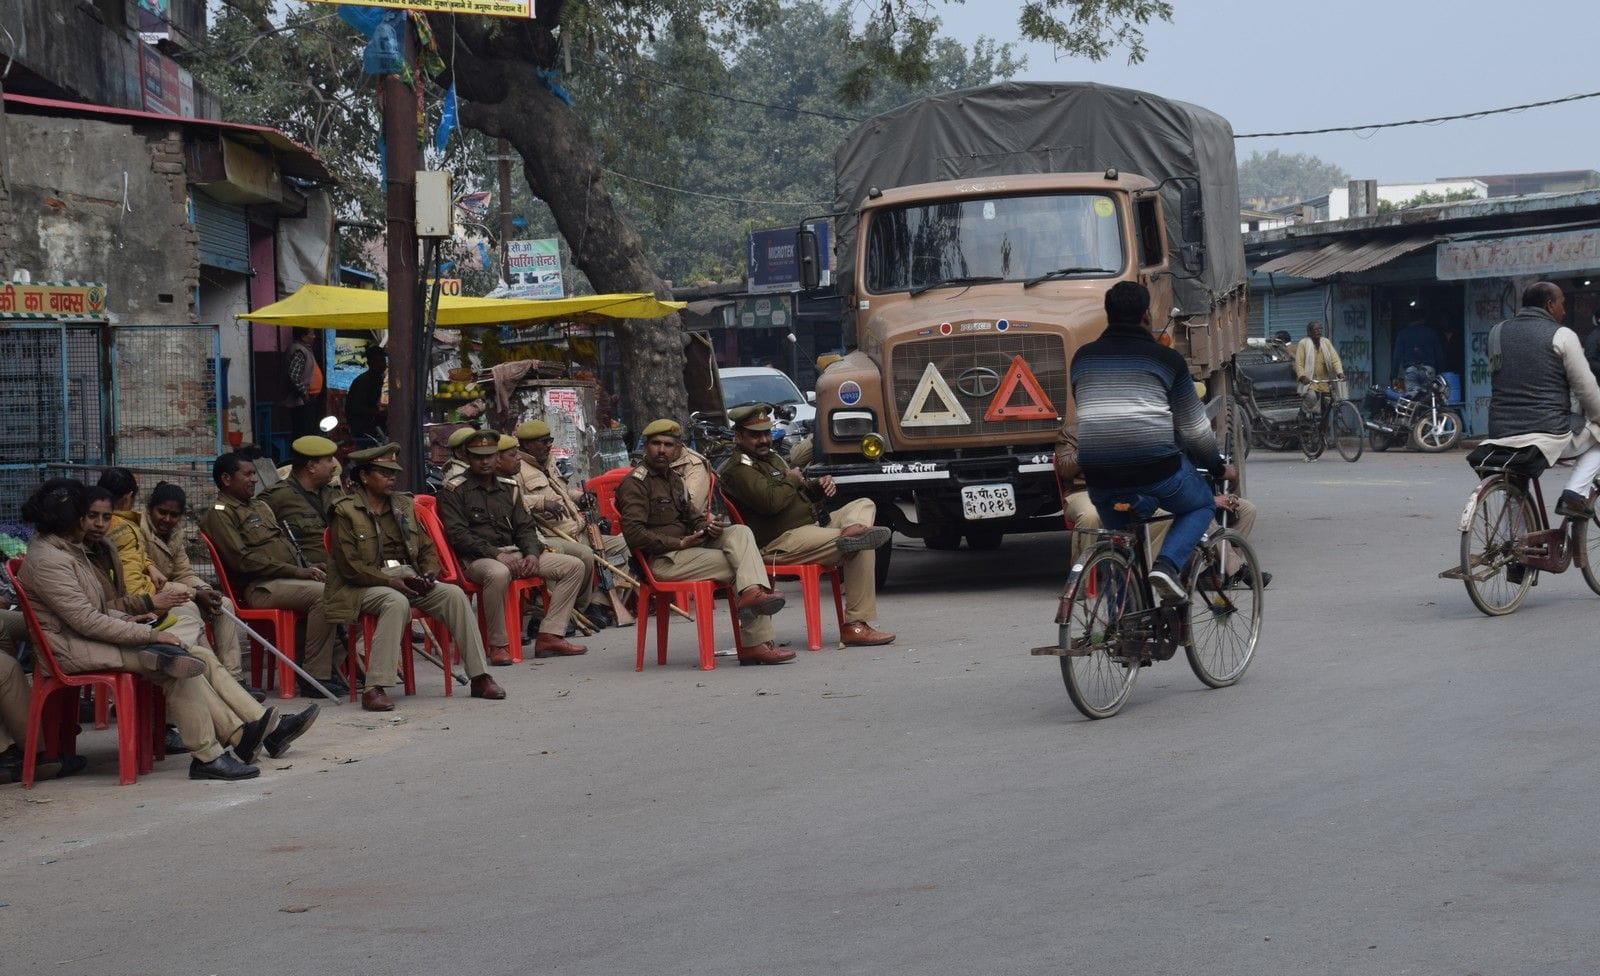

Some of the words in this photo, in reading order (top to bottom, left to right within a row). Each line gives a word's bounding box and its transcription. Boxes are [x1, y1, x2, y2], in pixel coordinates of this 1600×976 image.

[768, 245, 794, 259] MICROTEK
[24, 291, 43, 311] का
[49, 292, 83, 312] बाक्स
